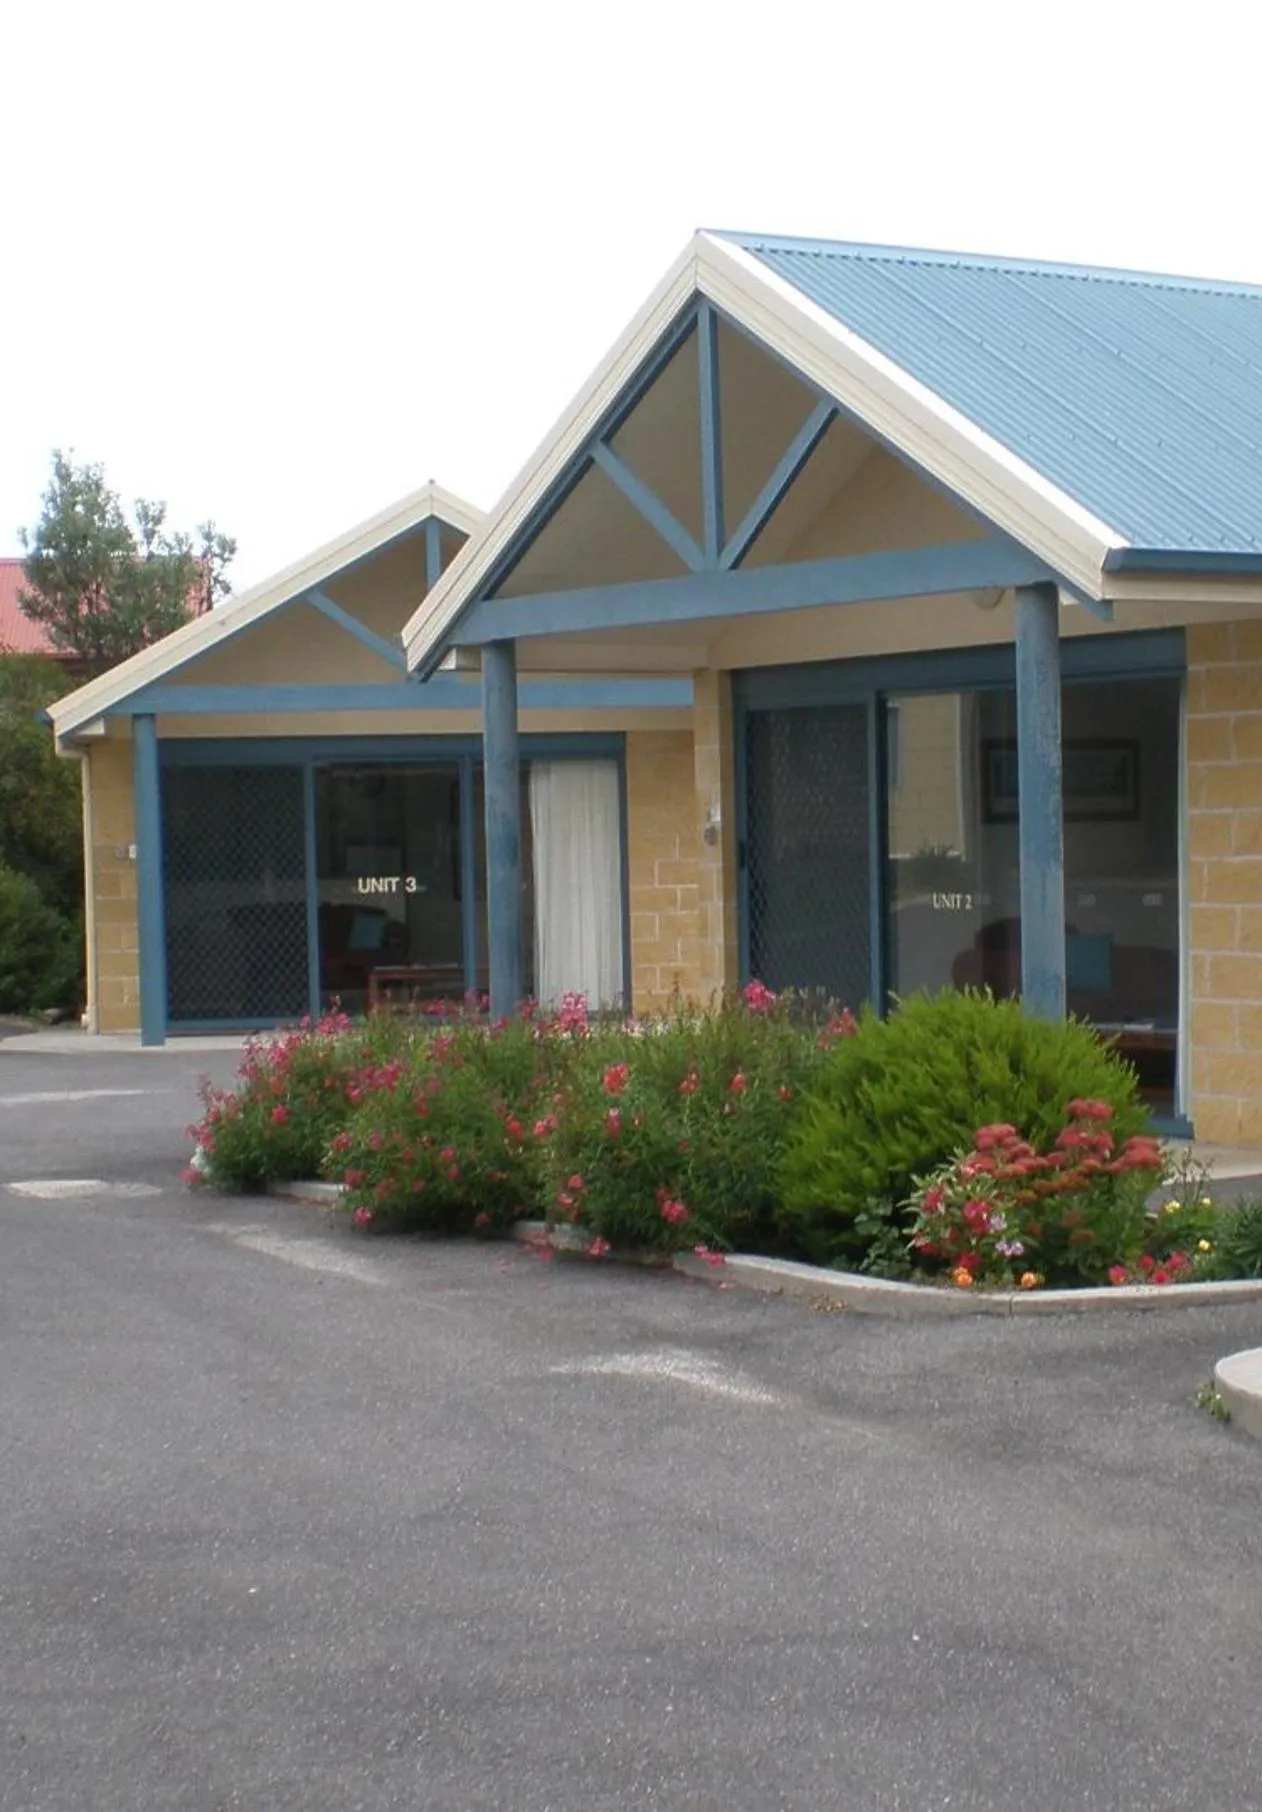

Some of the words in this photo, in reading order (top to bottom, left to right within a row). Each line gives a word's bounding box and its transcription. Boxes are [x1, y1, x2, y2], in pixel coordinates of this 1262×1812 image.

[358, 876, 400, 893] UNIT
[405, 875, 417, 893] 3
[933, 891, 962, 909] UNIT
[964, 893, 973, 910] 2
